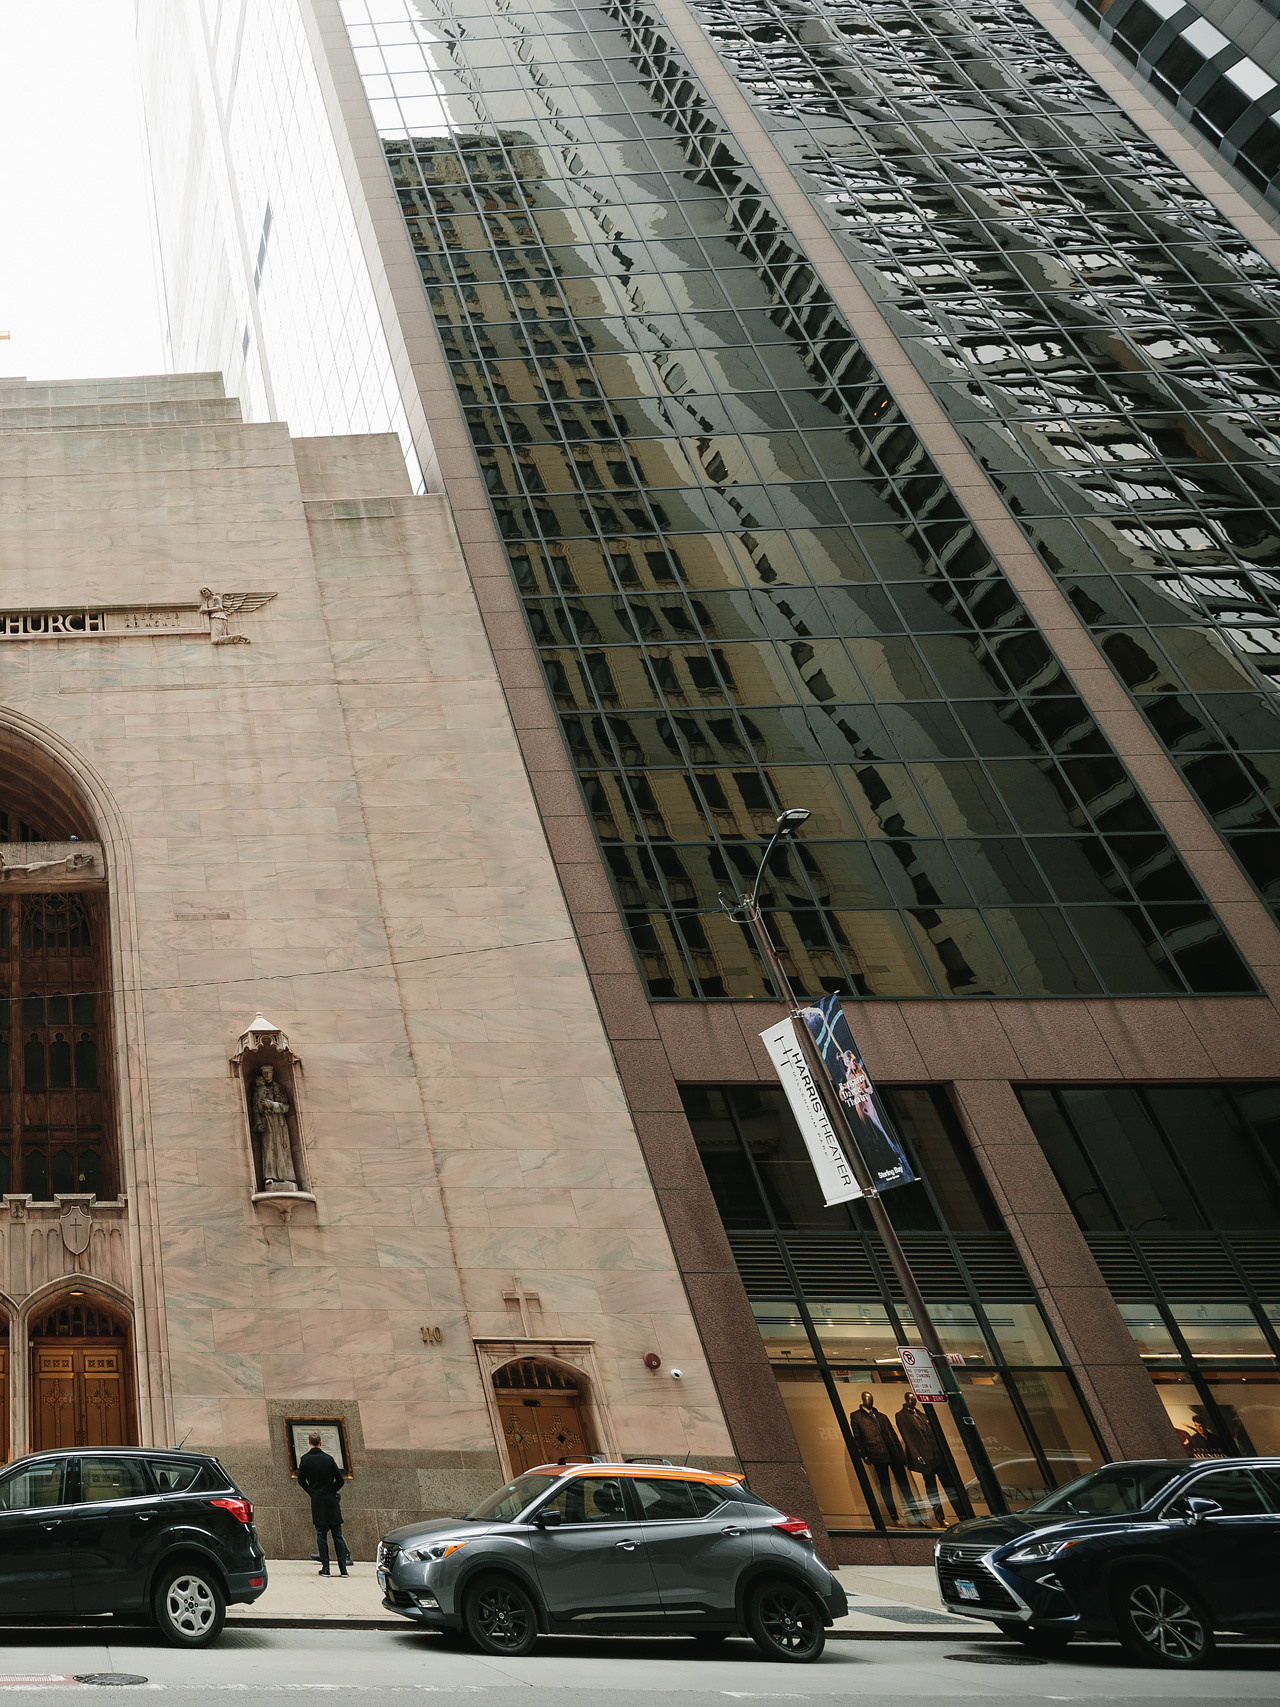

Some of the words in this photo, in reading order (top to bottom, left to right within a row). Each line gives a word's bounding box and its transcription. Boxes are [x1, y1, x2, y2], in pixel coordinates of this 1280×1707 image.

[792, 1052, 822, 1113] HARRIS
[818, 1113, 852, 1187] THEATER
[419, 1326, 443, 1343] 110
[965, 1486, 1050, 1501] CNALI
